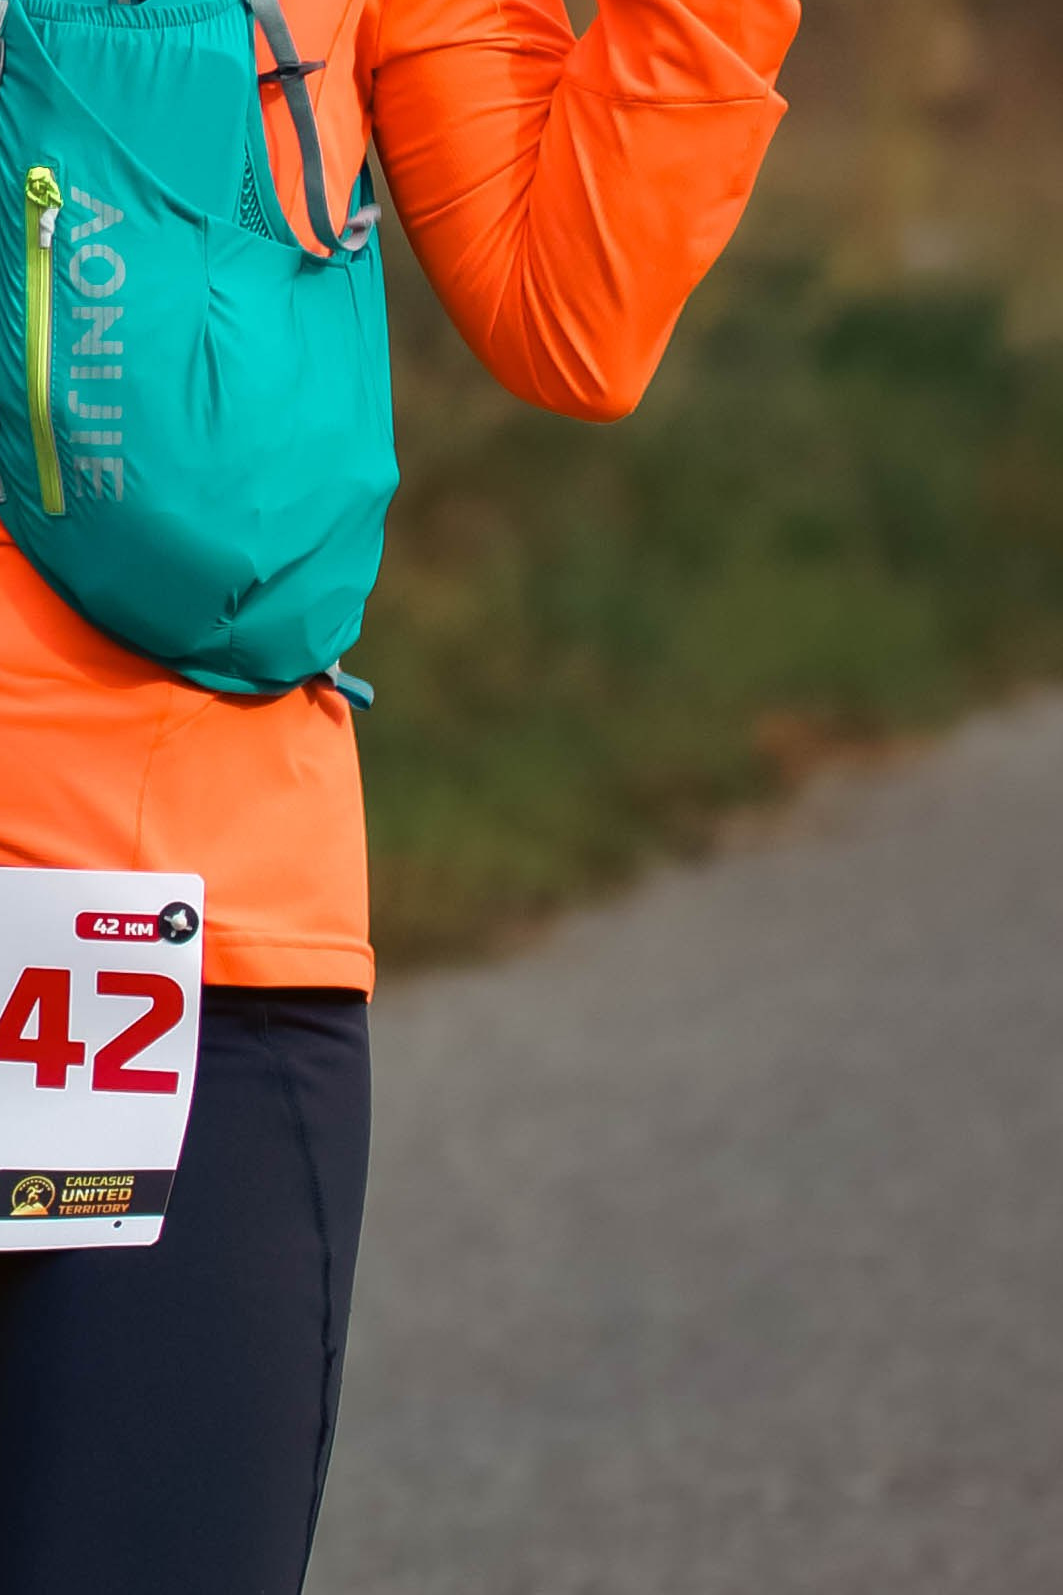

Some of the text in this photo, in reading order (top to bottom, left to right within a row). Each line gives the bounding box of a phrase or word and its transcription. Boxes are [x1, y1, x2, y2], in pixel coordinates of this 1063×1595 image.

[68, 186, 126, 501] AONIJIE
[93, 917, 120, 935] 42
[65, 1175, 135, 1187] CAUCASUS
[61, 1187, 132, 1203] UNITED
[58, 1203, 131, 1215] TERRITORY
